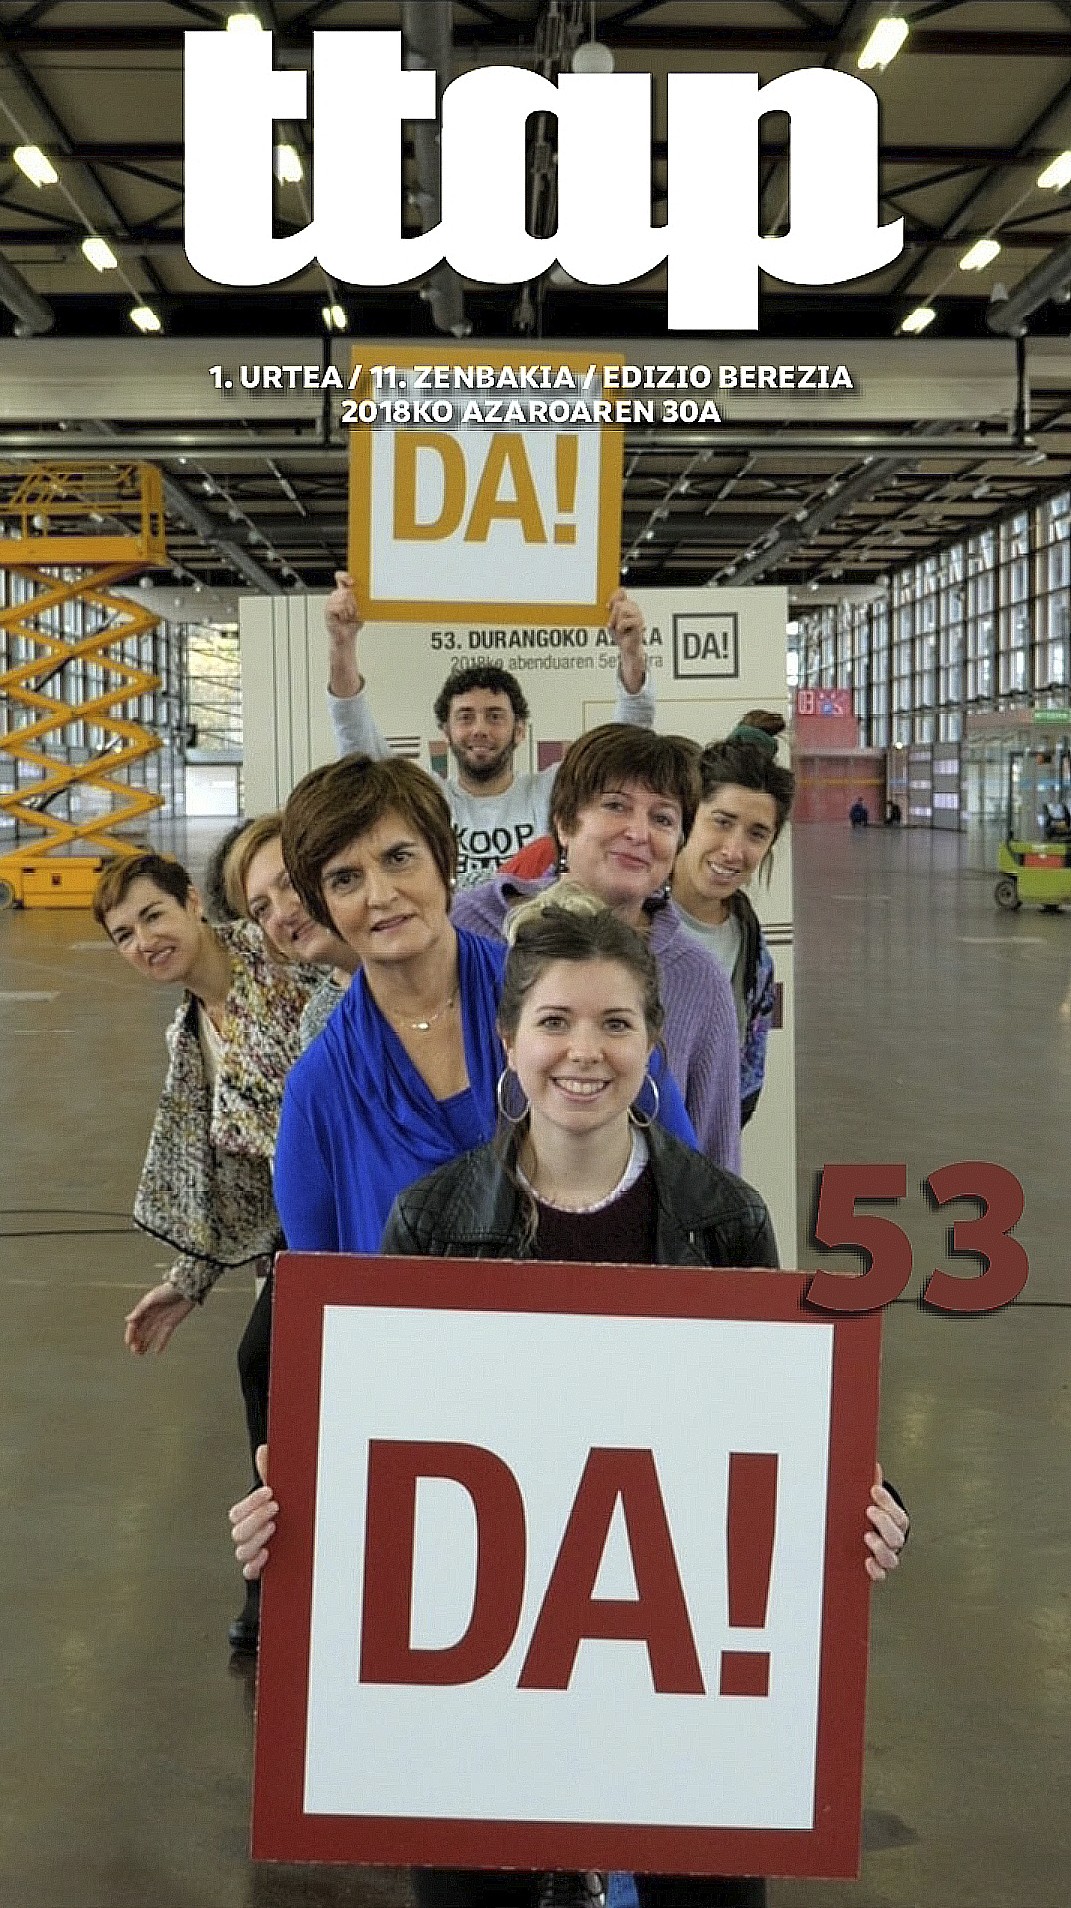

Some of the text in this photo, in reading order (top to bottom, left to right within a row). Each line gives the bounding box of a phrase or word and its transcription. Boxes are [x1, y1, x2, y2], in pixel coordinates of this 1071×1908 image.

[393, 431, 580, 544] DA!
[431, 631, 463, 650] 53.
[468, 628, 588, 650] DURANGOKO
[683, 632, 729, 660] DA!
[508, 652, 594, 670] abenduaren
[359, 1438, 779, 1698] DA!
